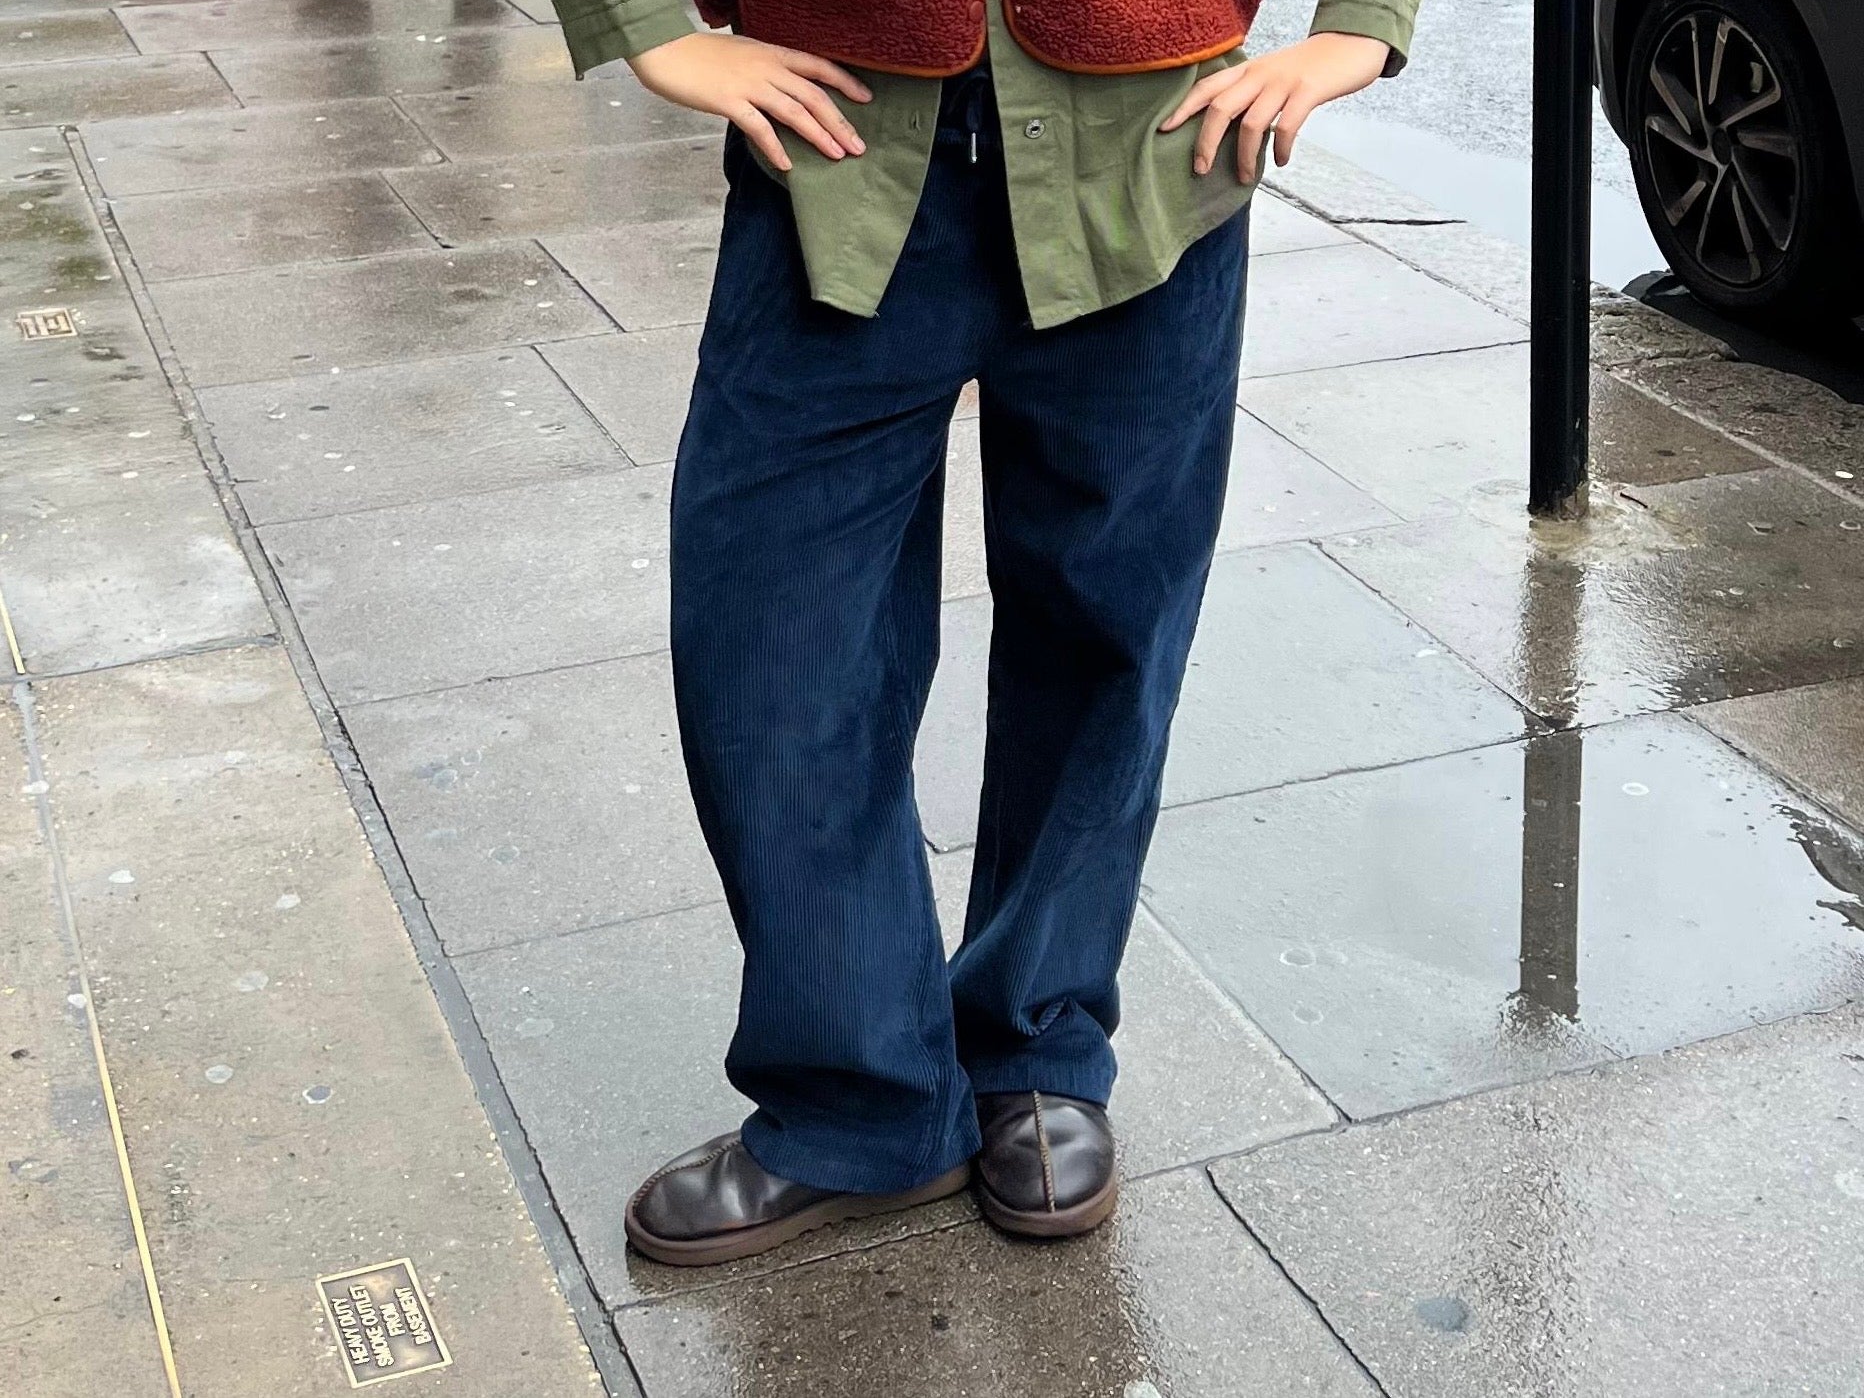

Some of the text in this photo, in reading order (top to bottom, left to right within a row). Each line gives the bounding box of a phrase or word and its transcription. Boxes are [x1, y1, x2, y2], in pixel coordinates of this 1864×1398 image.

[332, 1298, 370, 1365] HEAVY DUTY
[350, 1285, 395, 1367] SMOKE OUTLET
[379, 1303, 406, 1337] FROM
[394, 1287, 432, 1345] BASEMENT
